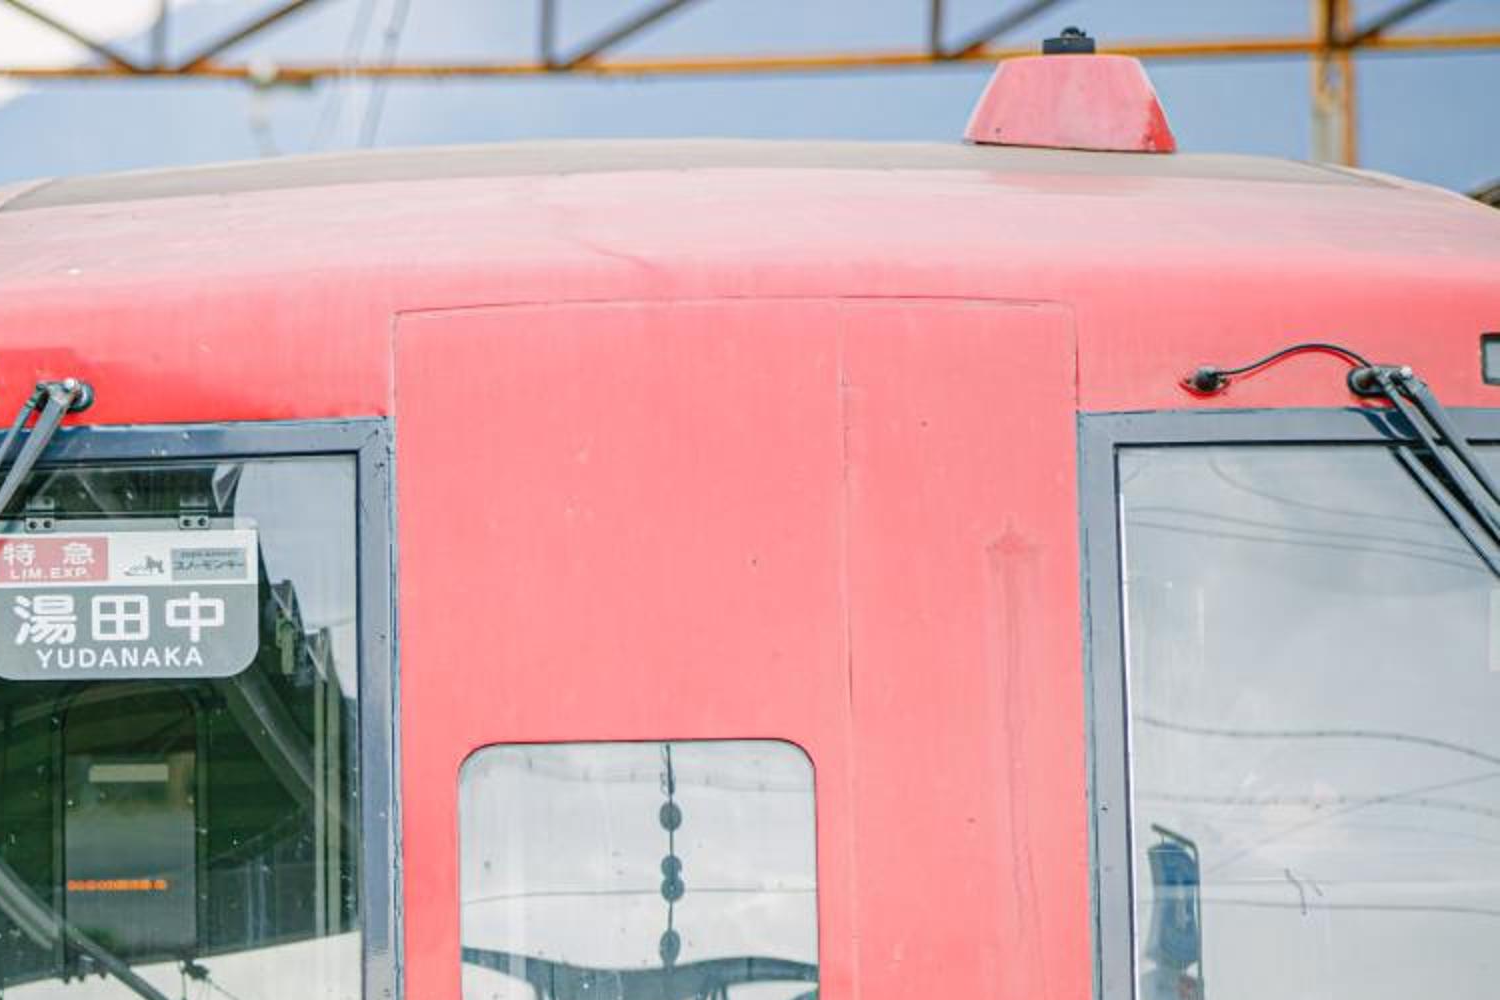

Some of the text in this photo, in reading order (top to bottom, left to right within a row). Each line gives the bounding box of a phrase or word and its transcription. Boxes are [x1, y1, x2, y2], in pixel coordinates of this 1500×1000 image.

[2, 542, 95, 566] 特急
[13, 591, 225, 644] 湯田中
[36, 646, 203, 669] YUDANAKA
